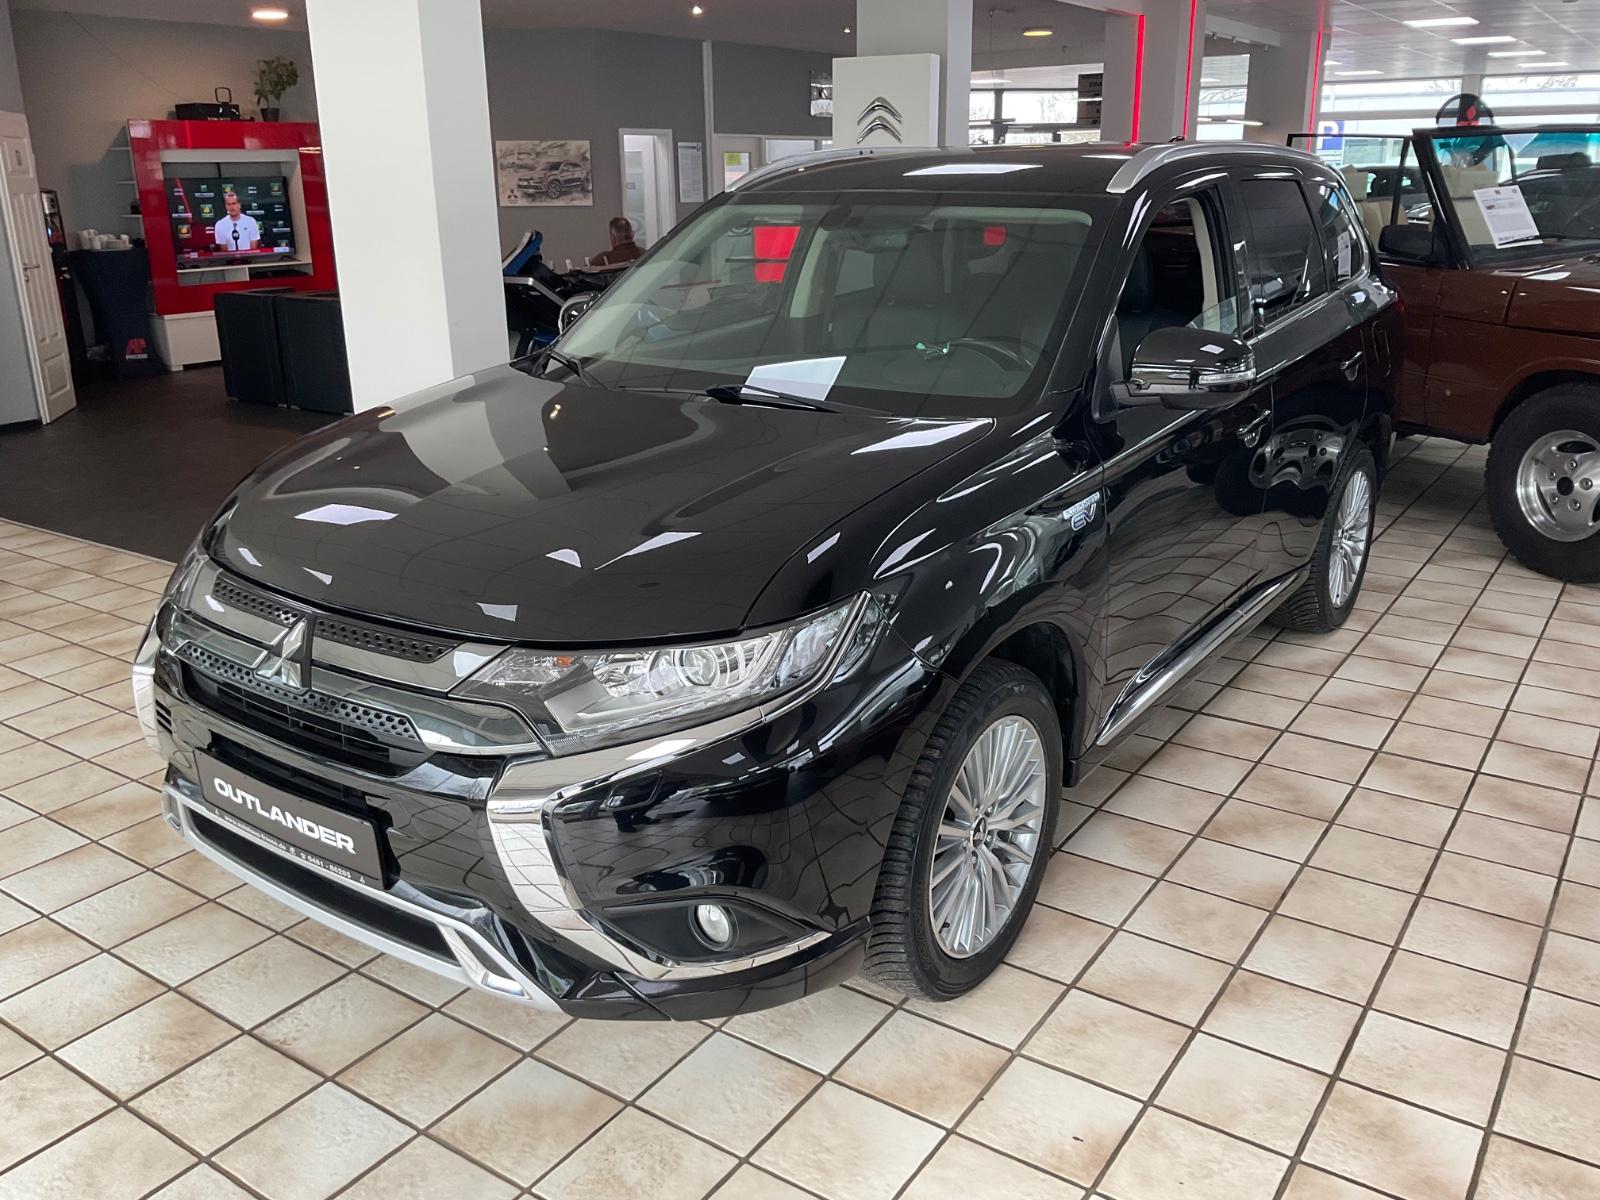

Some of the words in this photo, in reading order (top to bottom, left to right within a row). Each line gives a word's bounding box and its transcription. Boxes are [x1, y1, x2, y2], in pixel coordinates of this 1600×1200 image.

[1316, 121, 1340, 149] P
[1071, 503, 1097, 531] EV
[213, 777, 356, 854] OUTLANDER
